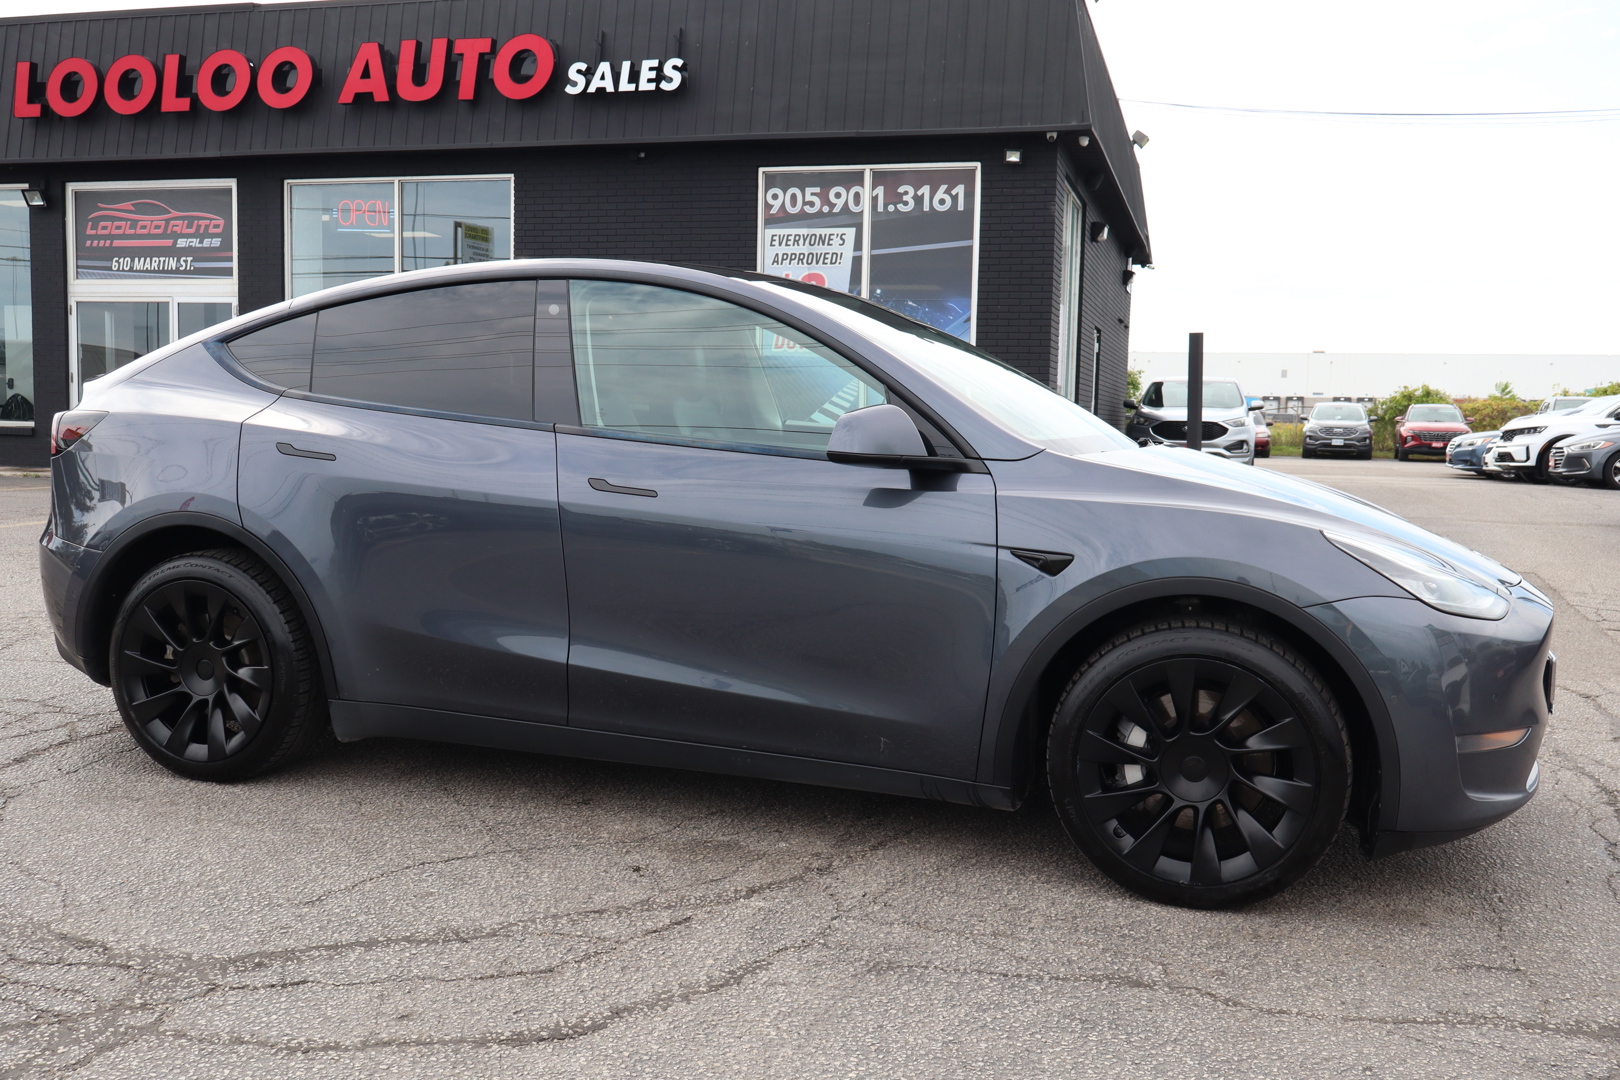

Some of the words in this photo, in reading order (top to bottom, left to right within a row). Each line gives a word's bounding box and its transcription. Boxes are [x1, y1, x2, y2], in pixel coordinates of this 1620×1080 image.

[13, 46, 314, 118] LOOLOO
[337, 33, 555, 104] AUTO
[564, 57, 685, 95] SALES
[766, 184, 965, 214] 905.901.3161
[338, 200, 389, 226] OPEN
[85, 220, 166, 235] LOOLOO
[167, 219, 225, 234] AUTO
[176, 238, 222, 248] SALES
[769, 232, 847, 247] EVERYONE'S
[111, 257, 131, 271] 610
[133, 257, 177, 271] MARTIN
[179, 256, 194, 271] ST.
[771, 251, 844, 266] APPROVED!
